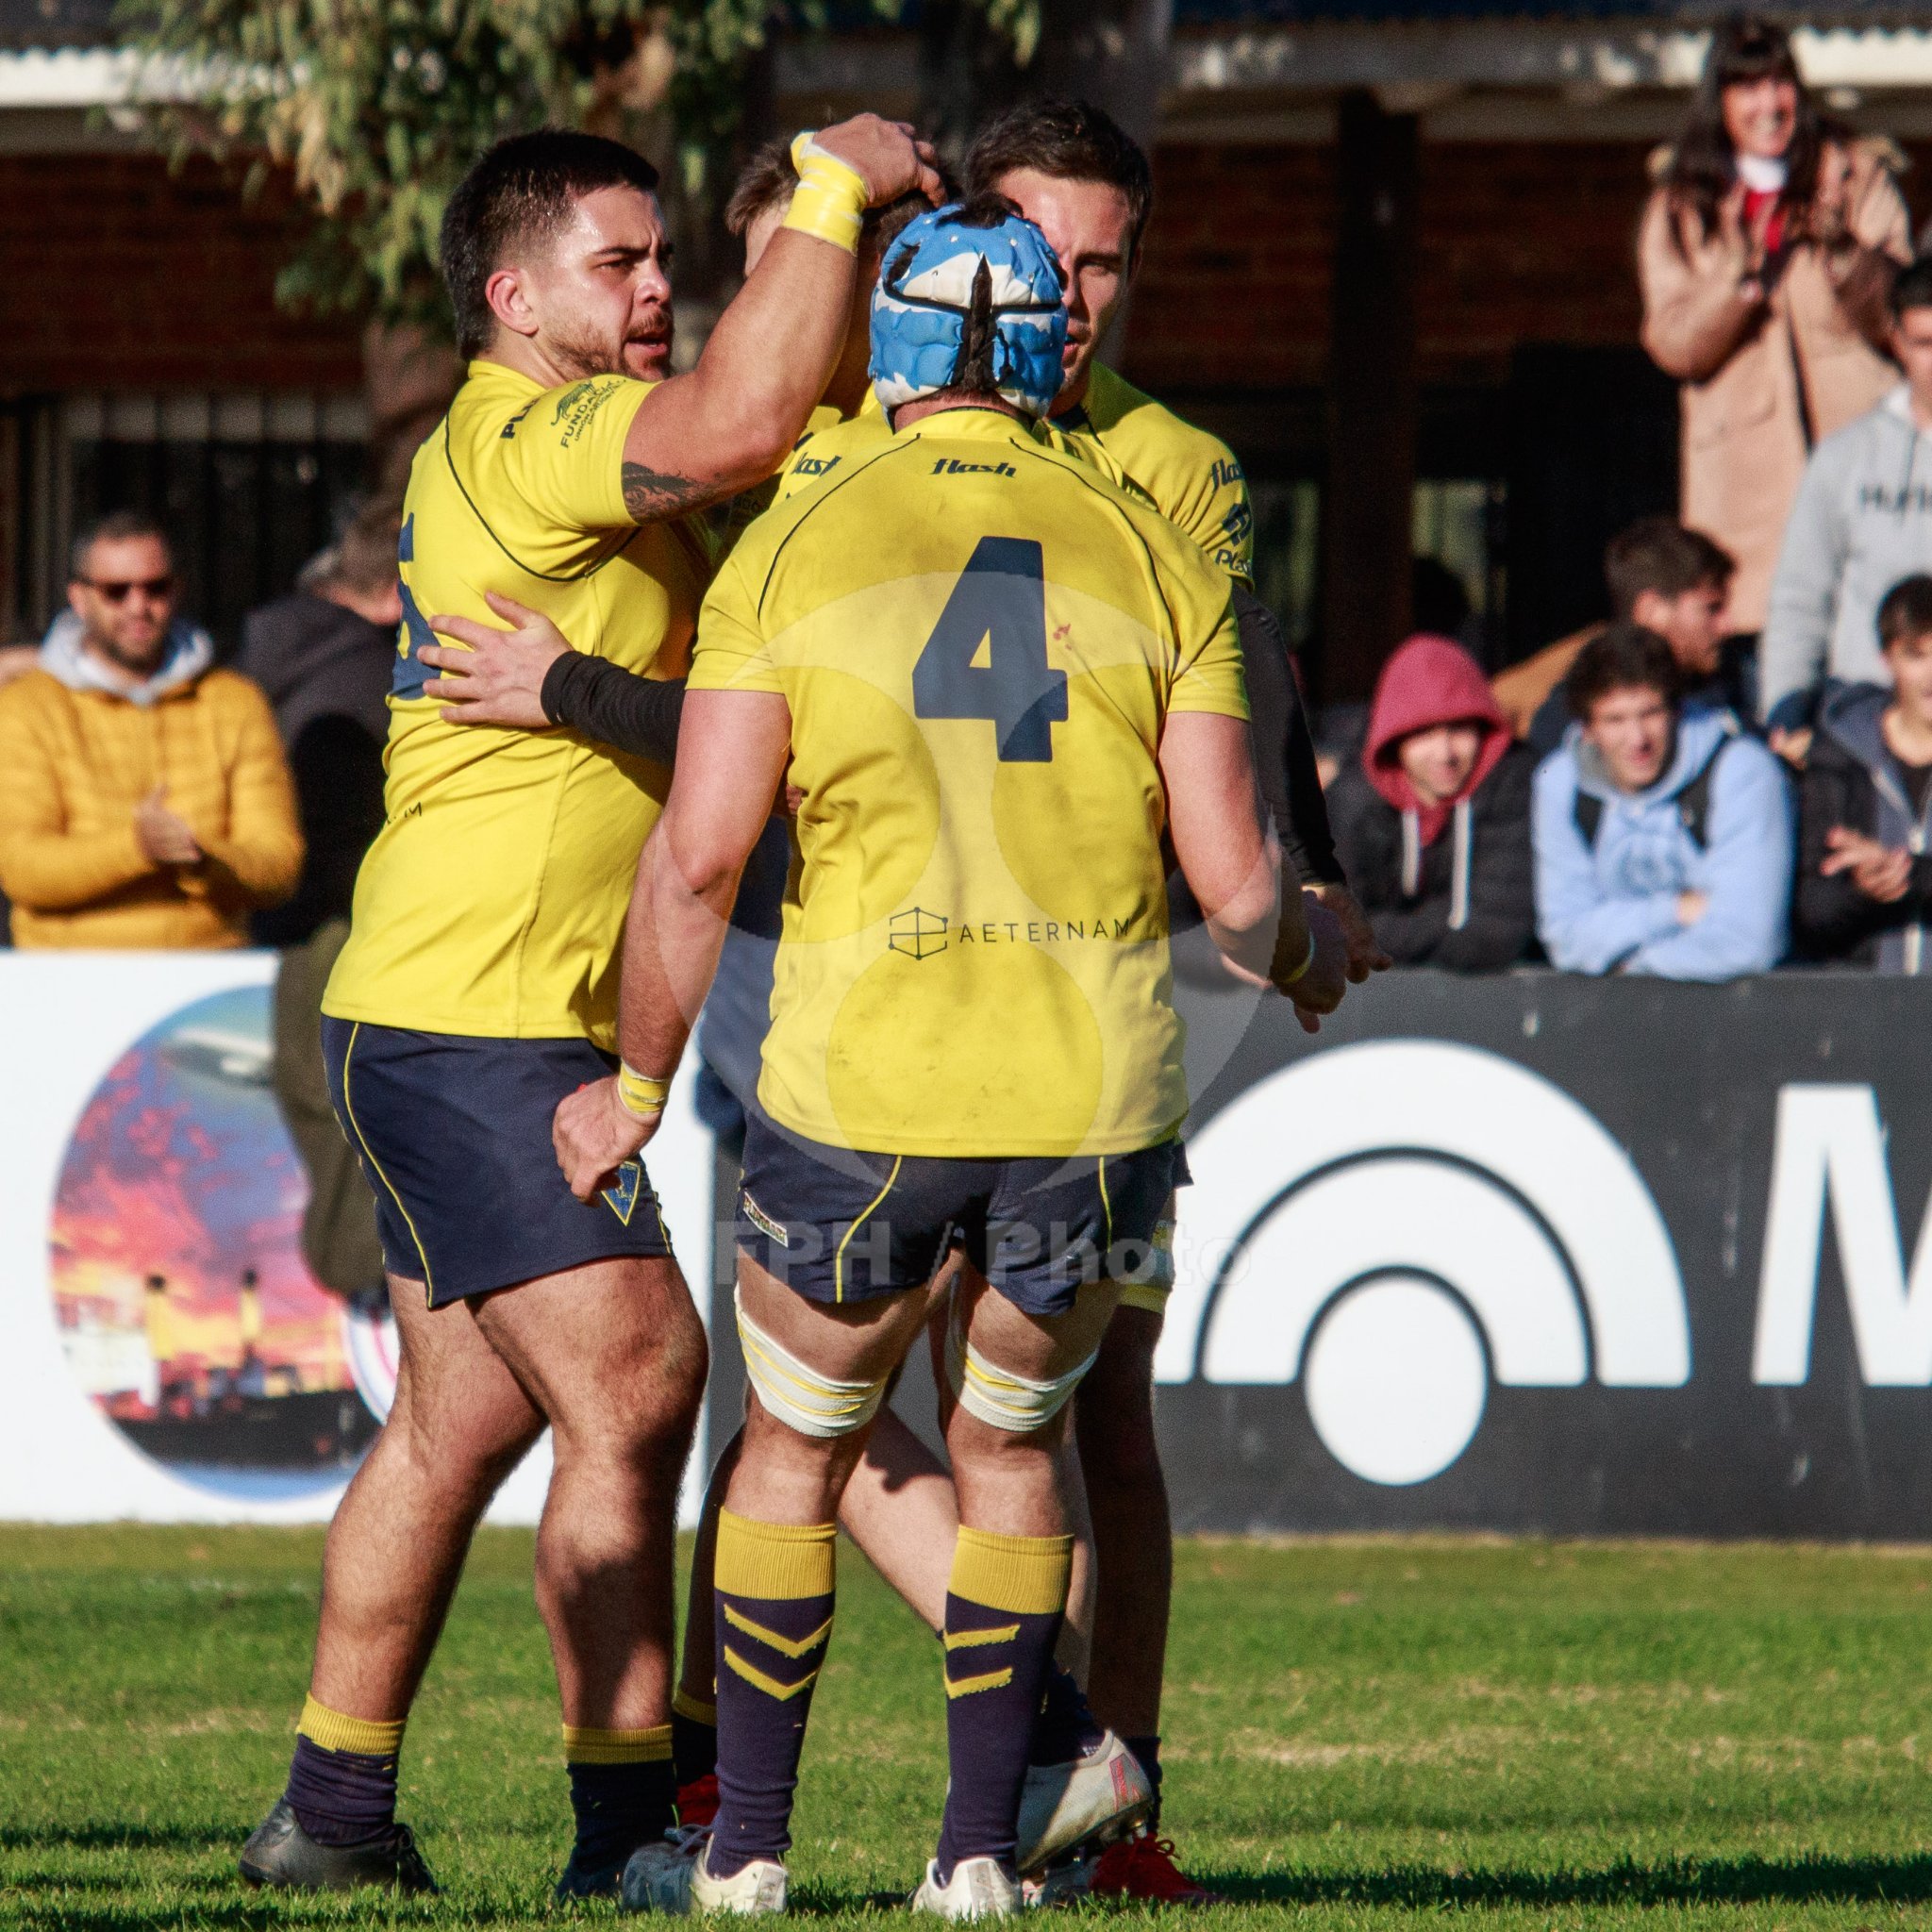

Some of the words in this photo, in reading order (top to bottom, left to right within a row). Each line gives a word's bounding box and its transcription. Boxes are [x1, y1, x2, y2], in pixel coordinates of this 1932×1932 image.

[928, 458, 1016, 477] flash
[912, 536, 1069, 762] 4
[958, 918, 1132, 944] AETERNAM
